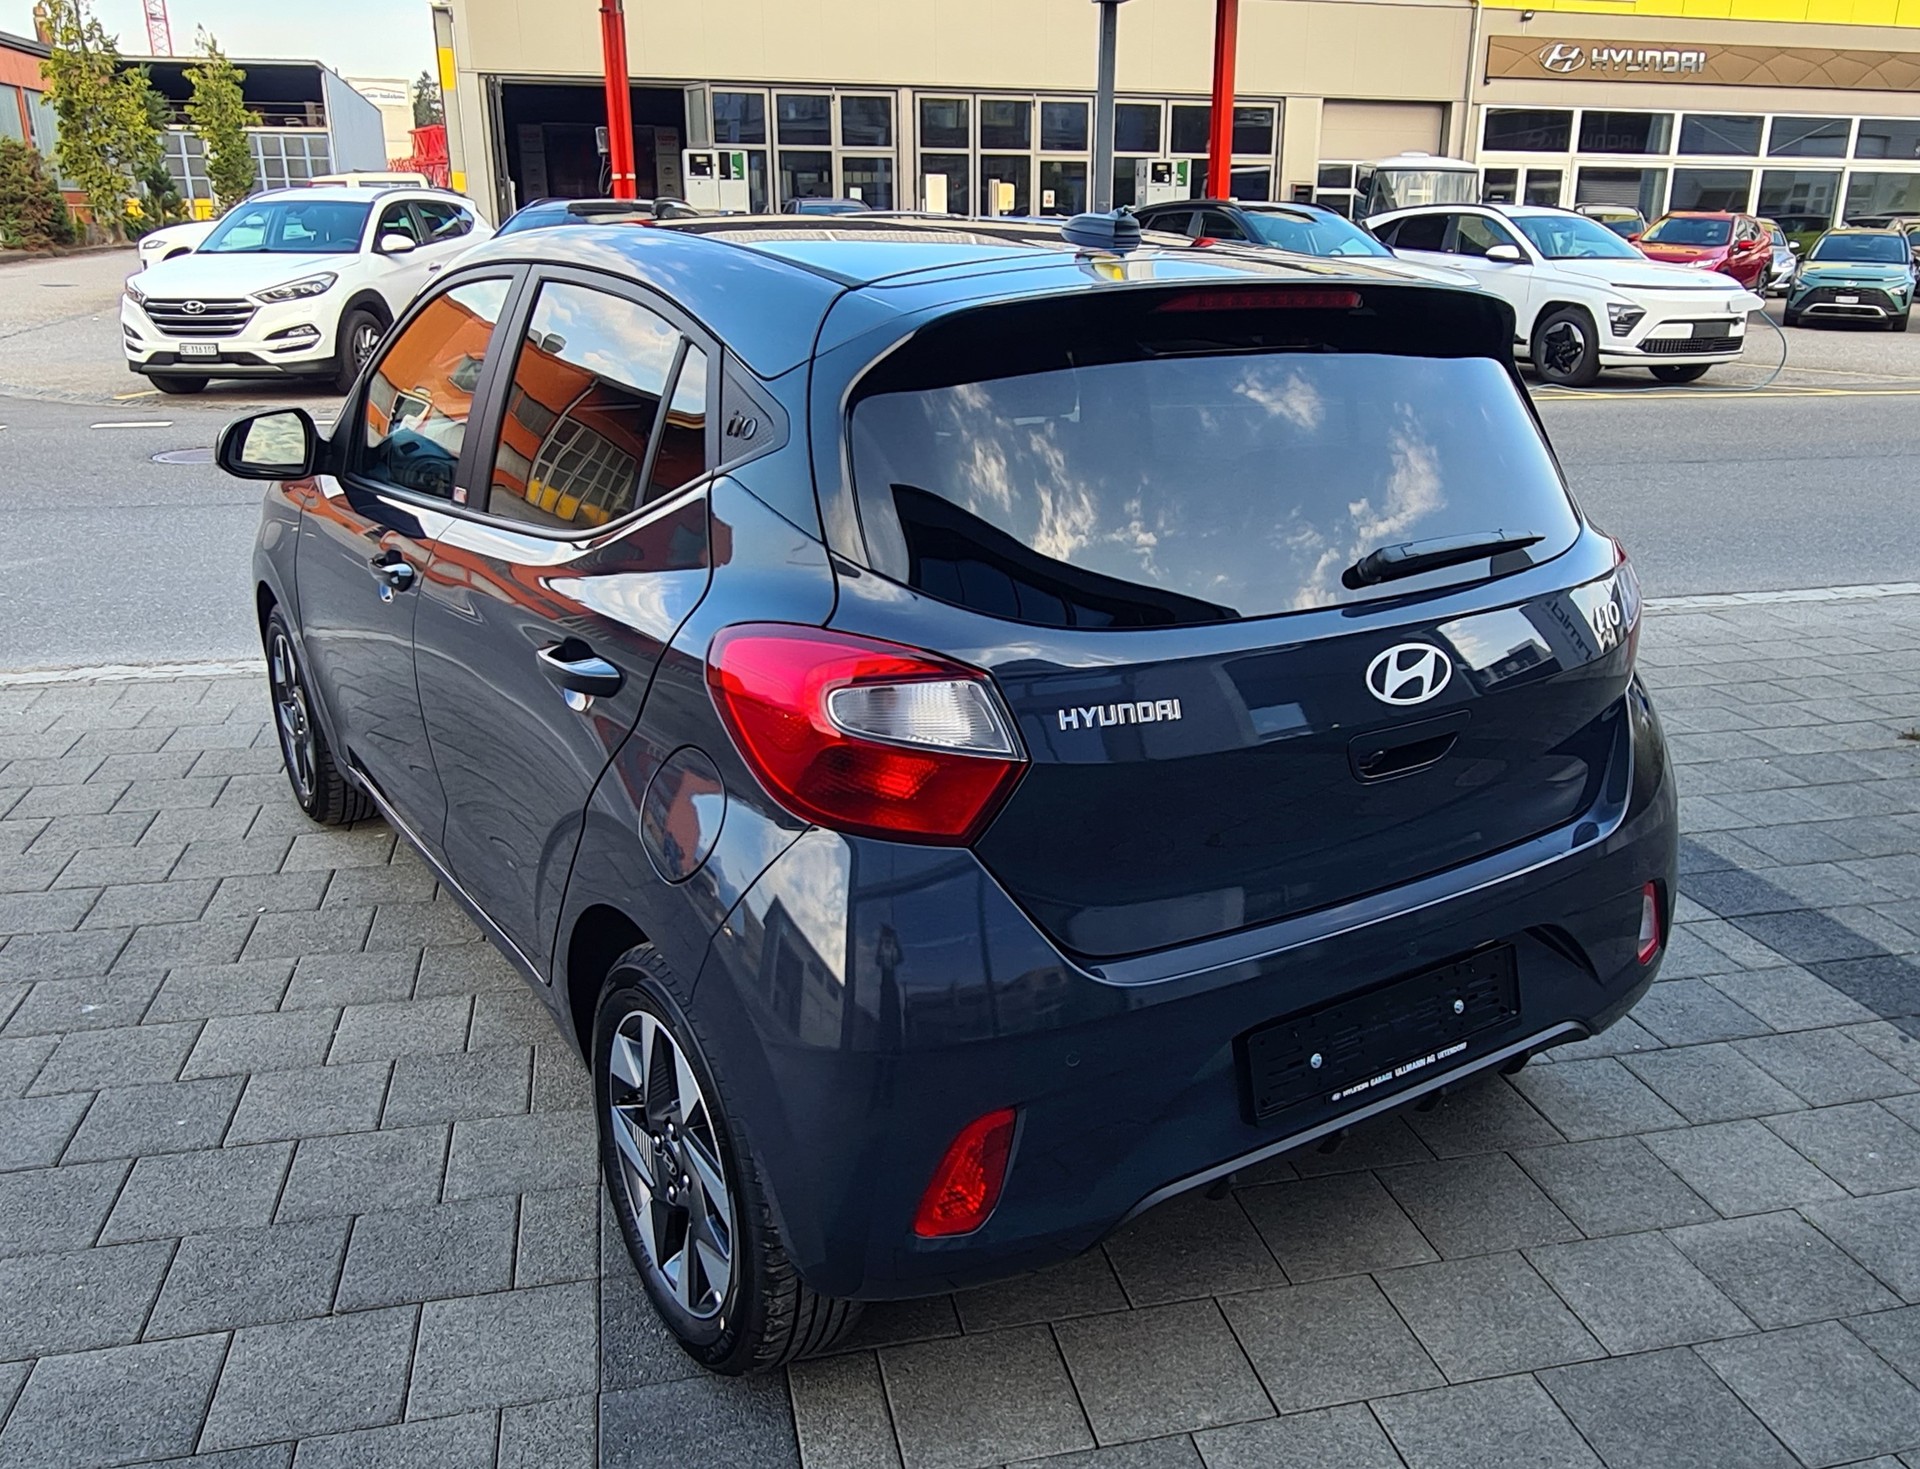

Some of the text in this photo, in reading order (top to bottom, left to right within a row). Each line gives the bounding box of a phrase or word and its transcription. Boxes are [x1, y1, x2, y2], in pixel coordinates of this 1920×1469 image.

[1590, 47, 1707, 73] HYUNDAI
[726, 410, 758, 440] i10
[1058, 698, 1182, 731] HYUNDAI
[1370, 1071, 1393, 1087] GARAGE
[1394, 1057, 1426, 1078] ULLMANN
[1426, 1053, 1436, 1065] AG
